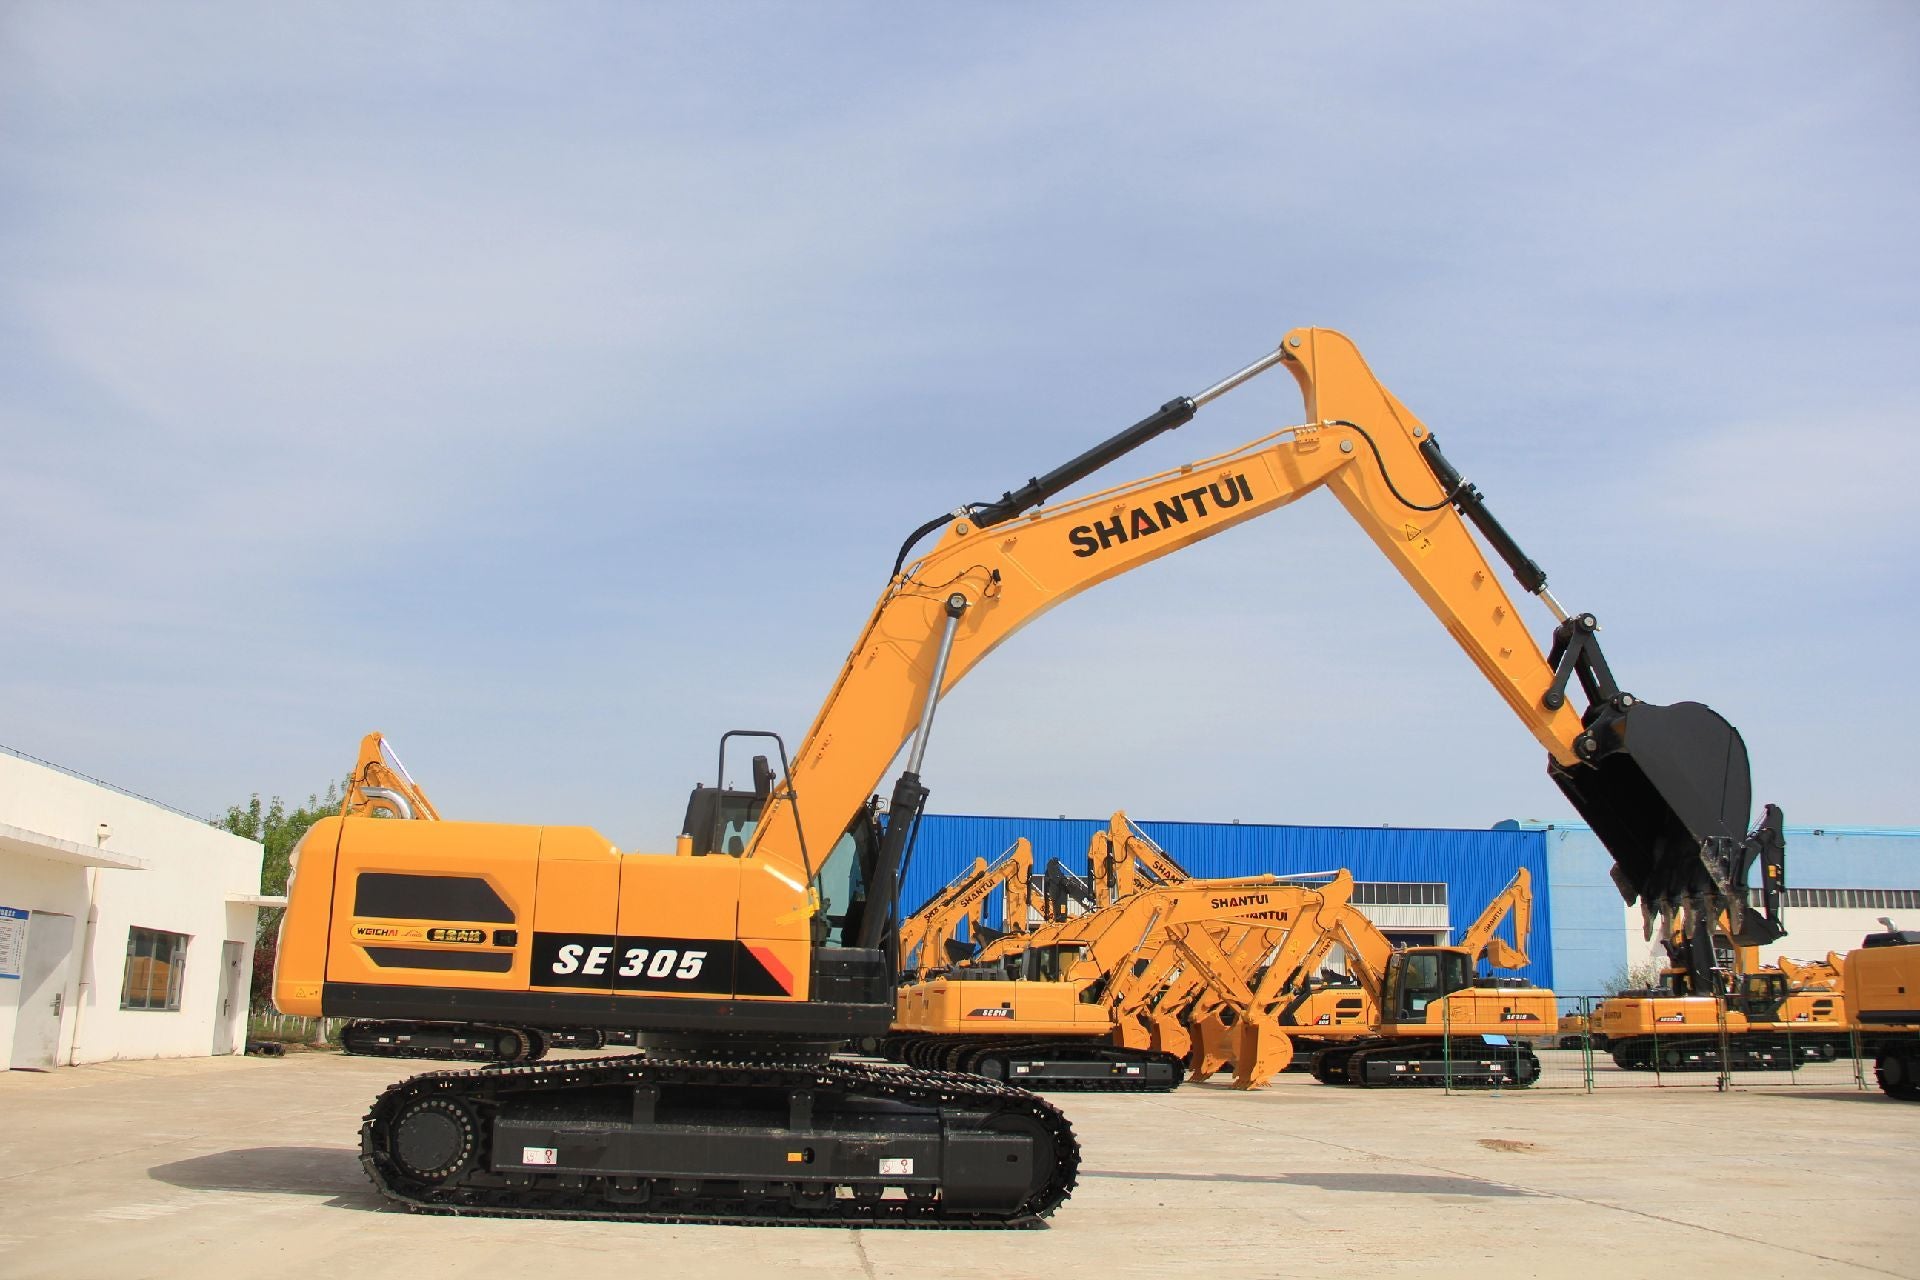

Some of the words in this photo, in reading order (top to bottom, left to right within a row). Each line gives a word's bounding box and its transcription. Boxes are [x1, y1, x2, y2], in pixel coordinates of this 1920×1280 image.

[1068, 473, 1254, 558] SHANTUI
[960, 878, 995, 907] SHANTUI
[1211, 894, 1269, 909] SHANTUI
[357, 927, 398, 937] WEICHAI
[1483, 907, 1504, 933] SHANTUI
[552, 944, 613, 975] SE
[618, 948, 708, 980] 305
